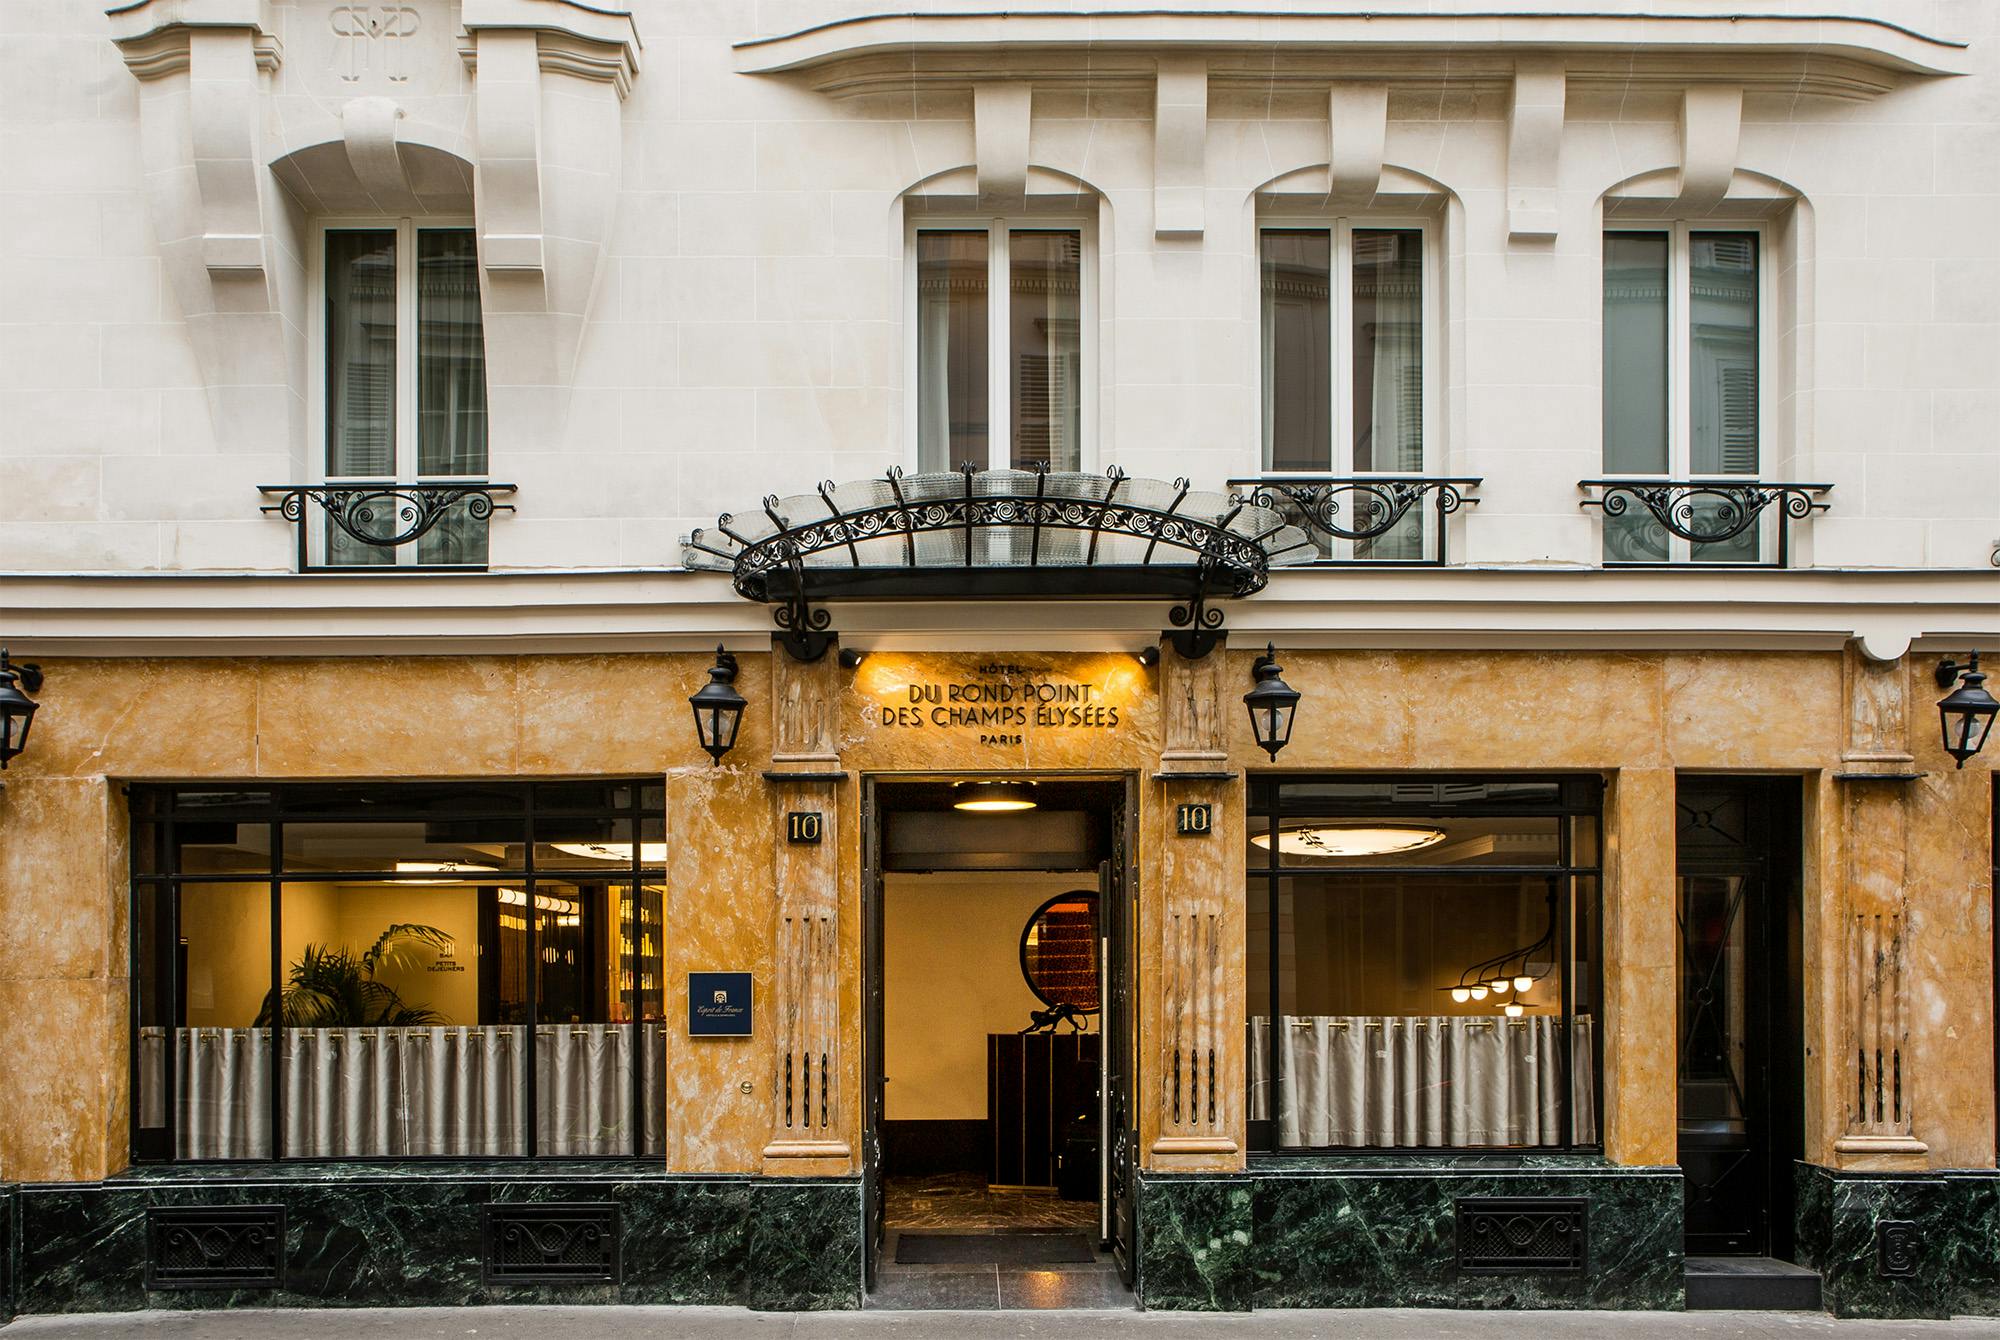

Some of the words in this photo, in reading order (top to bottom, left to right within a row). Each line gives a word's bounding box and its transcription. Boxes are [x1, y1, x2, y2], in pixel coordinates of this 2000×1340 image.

[979, 663, 1023, 674] HÔTEL
[909, 684, 938, 703] DU
[949, 684, 1014, 702] ROND
[1024, 684, 1092, 702] POINT
[882, 707, 921, 726] DES
[931, 707, 1026, 726] CHAMPS
[1036, 703, 1119, 726] ÉLYSÉES
[980, 734, 1022, 744] PARIS
[792, 815, 818, 839] 10
[1182, 807, 1207, 830] 10
